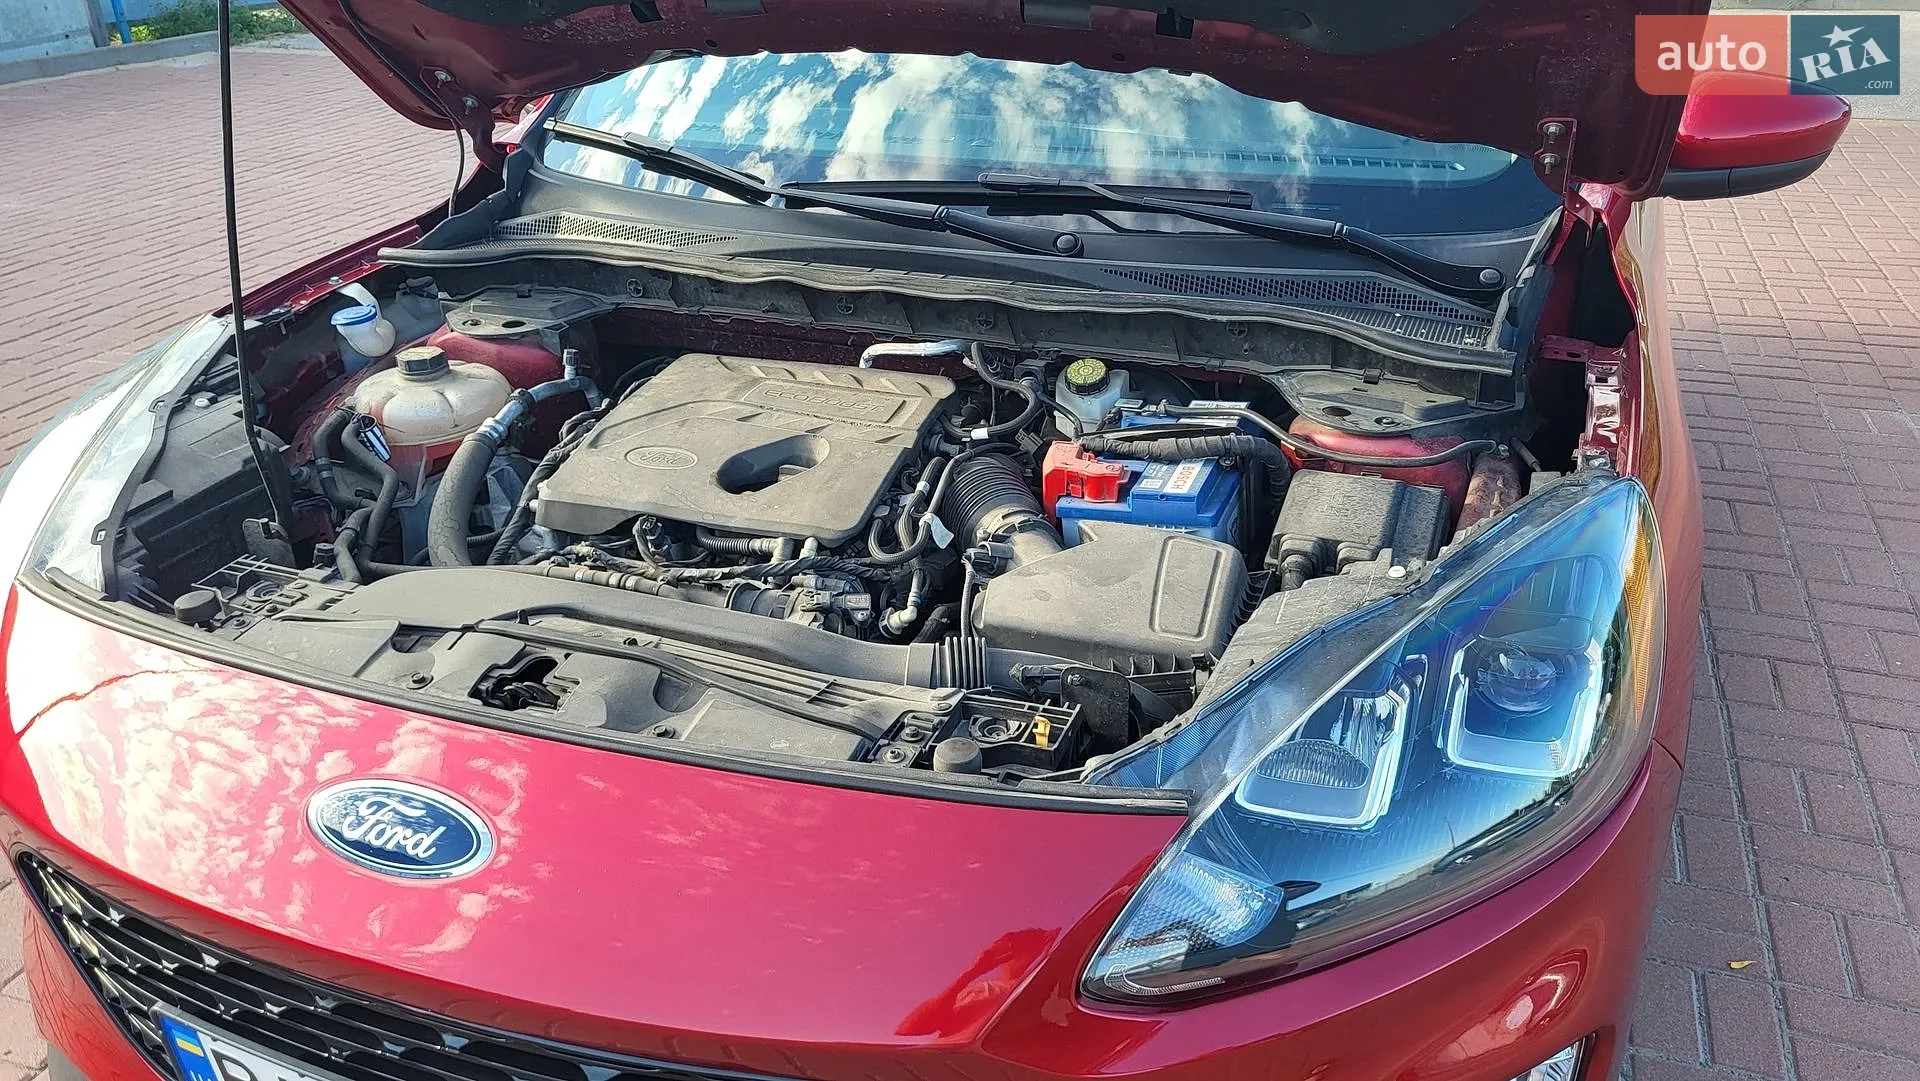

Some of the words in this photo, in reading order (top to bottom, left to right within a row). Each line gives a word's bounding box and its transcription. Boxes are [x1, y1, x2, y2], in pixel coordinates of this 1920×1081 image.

[640, 450, 682, 465] Ford
[1171, 465, 1195, 490] BOSCH
[341, 796, 447, 859] Ford
